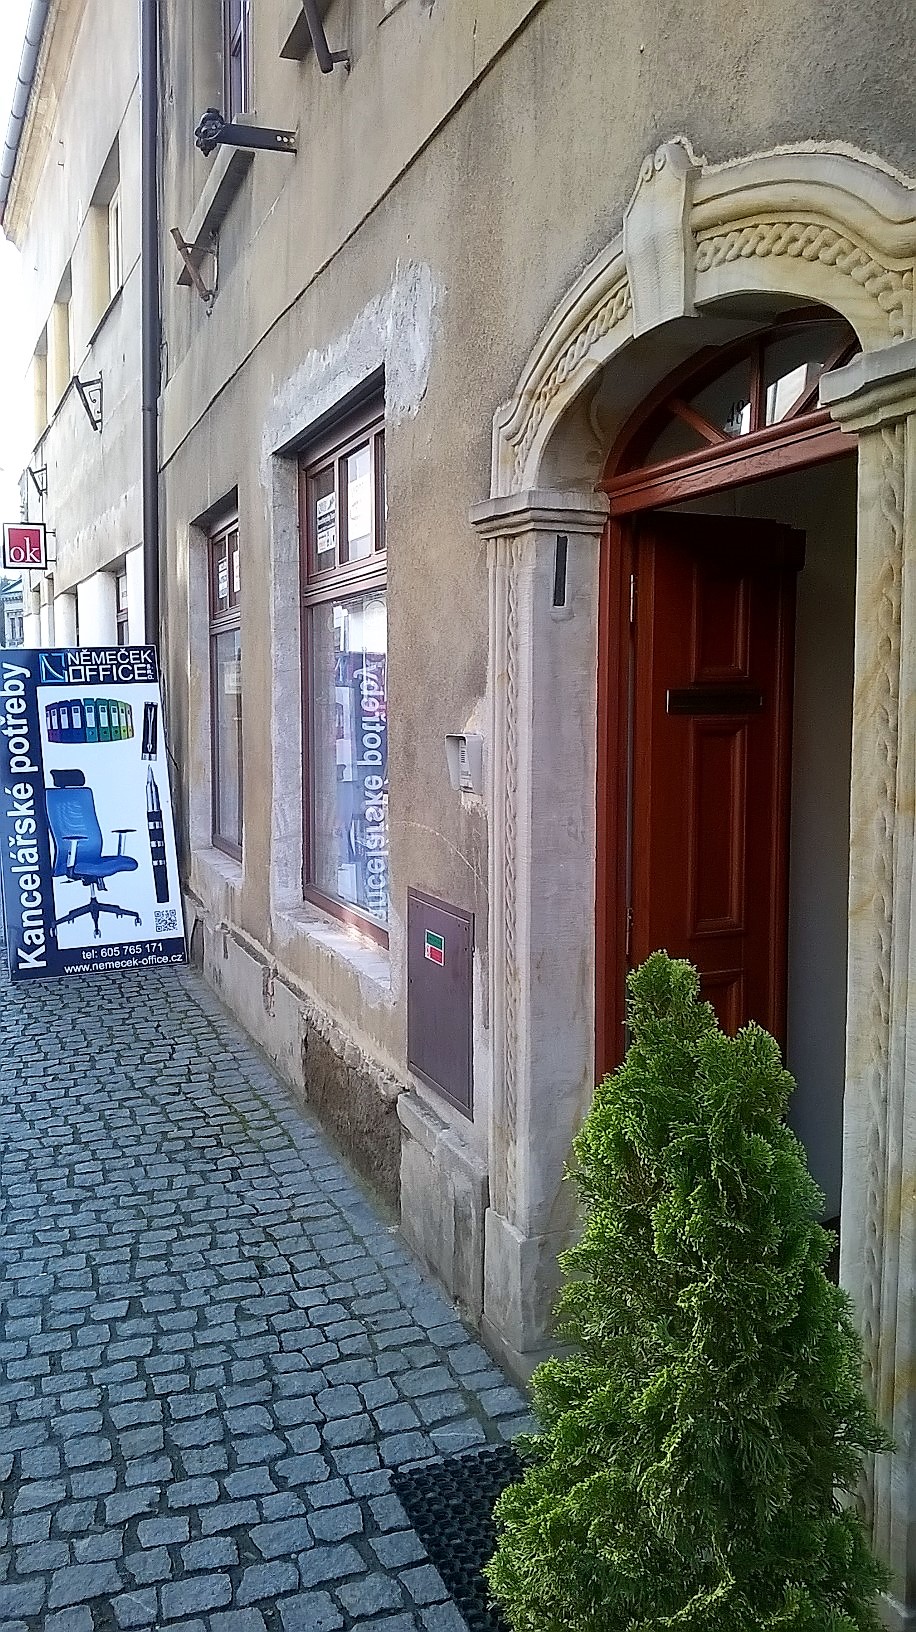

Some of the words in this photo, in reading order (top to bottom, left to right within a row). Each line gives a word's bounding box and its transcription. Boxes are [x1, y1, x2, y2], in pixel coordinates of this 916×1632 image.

[10, 536, 40, 562] ok
[67, 648, 152, 665] NĚMEČEK
[69, 664, 148, 682] OFFICE
[0, 662, 38, 774] potřeby
[5, 782, 46, 970] Kancelářské
[82, 949, 98, 960] tel:
[100, 947, 120, 958] 605
[122, 944, 142, 955] 765
[145, 942, 164, 953] 171
[64, 954, 183, 974] www.nemecek-office.cz
